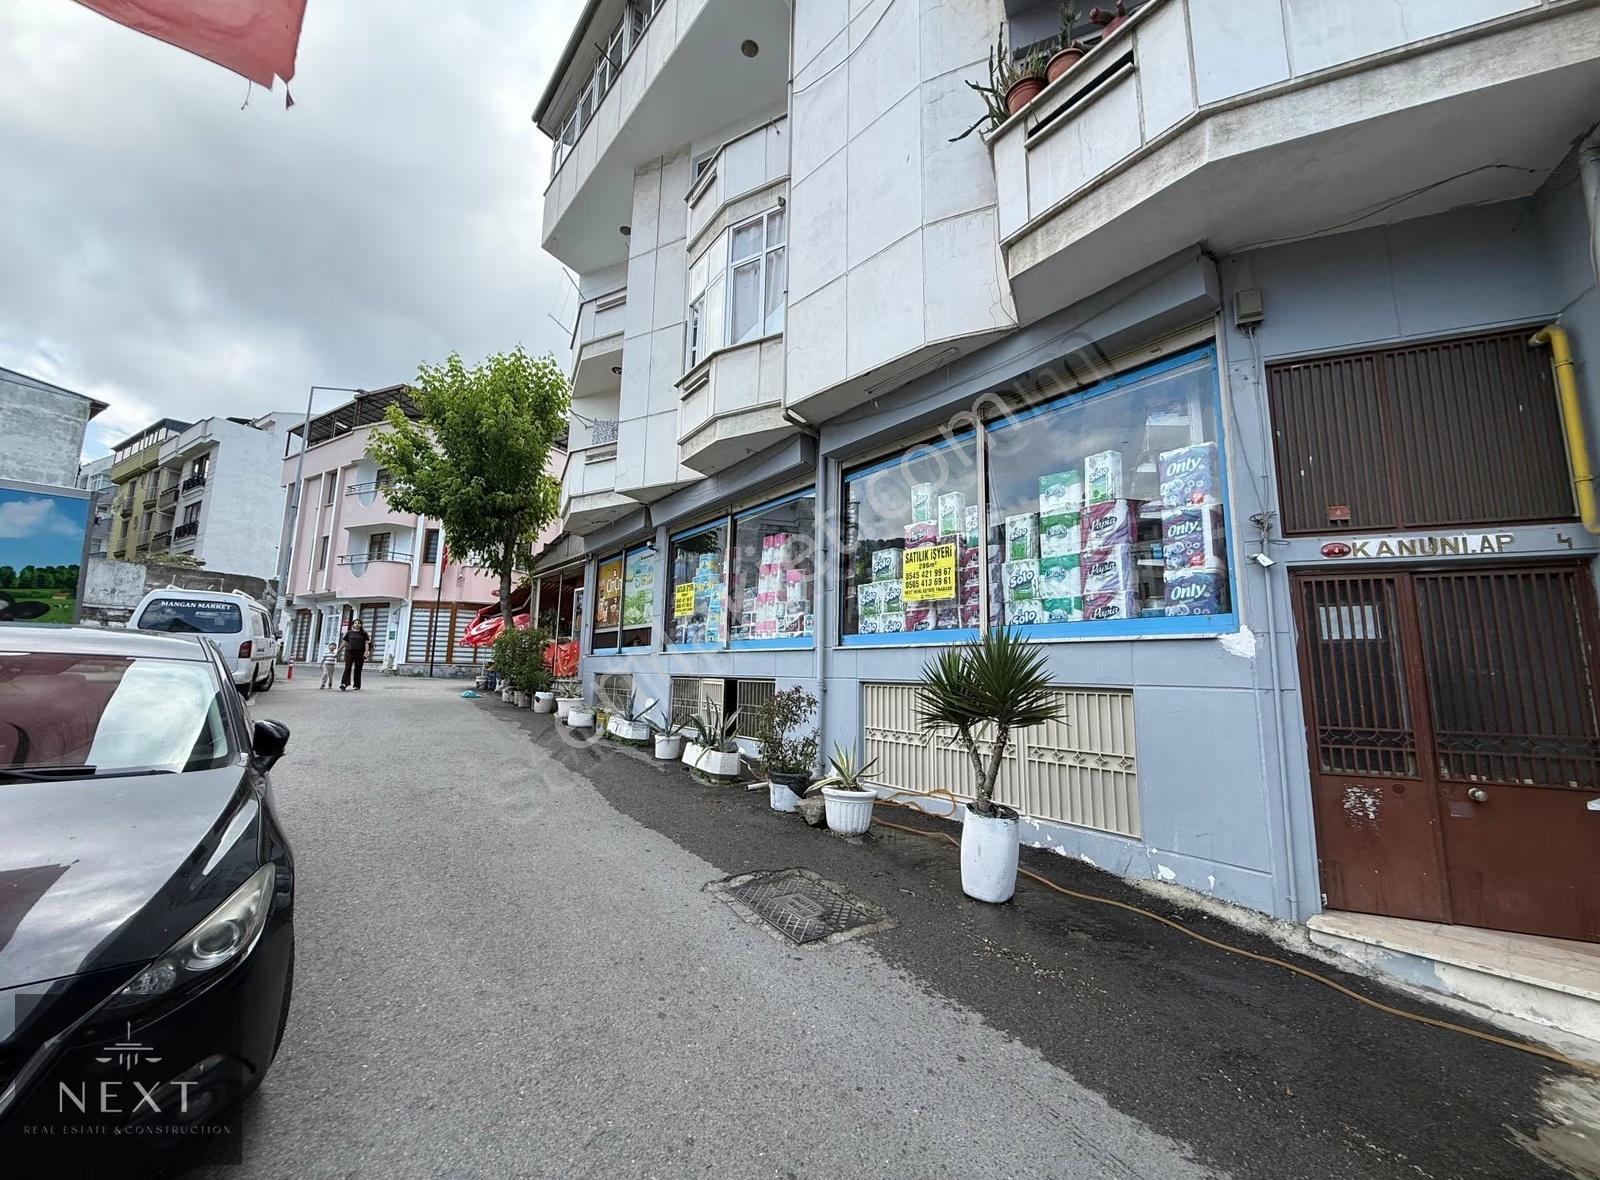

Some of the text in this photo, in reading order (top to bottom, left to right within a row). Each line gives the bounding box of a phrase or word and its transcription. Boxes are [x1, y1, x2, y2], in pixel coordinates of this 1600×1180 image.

[1166, 458, 1200, 477] Only
[1090, 516, 1117, 532] Papia
[1167, 521, 1200, 538] Only
[1009, 527, 1027, 541] Solo
[905, 550, 929, 564] SATILIK
[874, 557, 892, 573] Solo
[1090, 562, 1116, 578] Papia
[905, 567, 952, 580] 0545 421 99 67
[1009, 570, 1034, 589] Solo
[921, 578, 932, 587] 413
[943, 576, 952, 584] 61
[861, 591, 877, 606] Solo
[884, 587, 901, 602] Solo
[1170, 584, 1206, 602] Only
[161, 600, 232, 611] MANGAN MARKET
[1012, 610, 1037, 625] Solo
